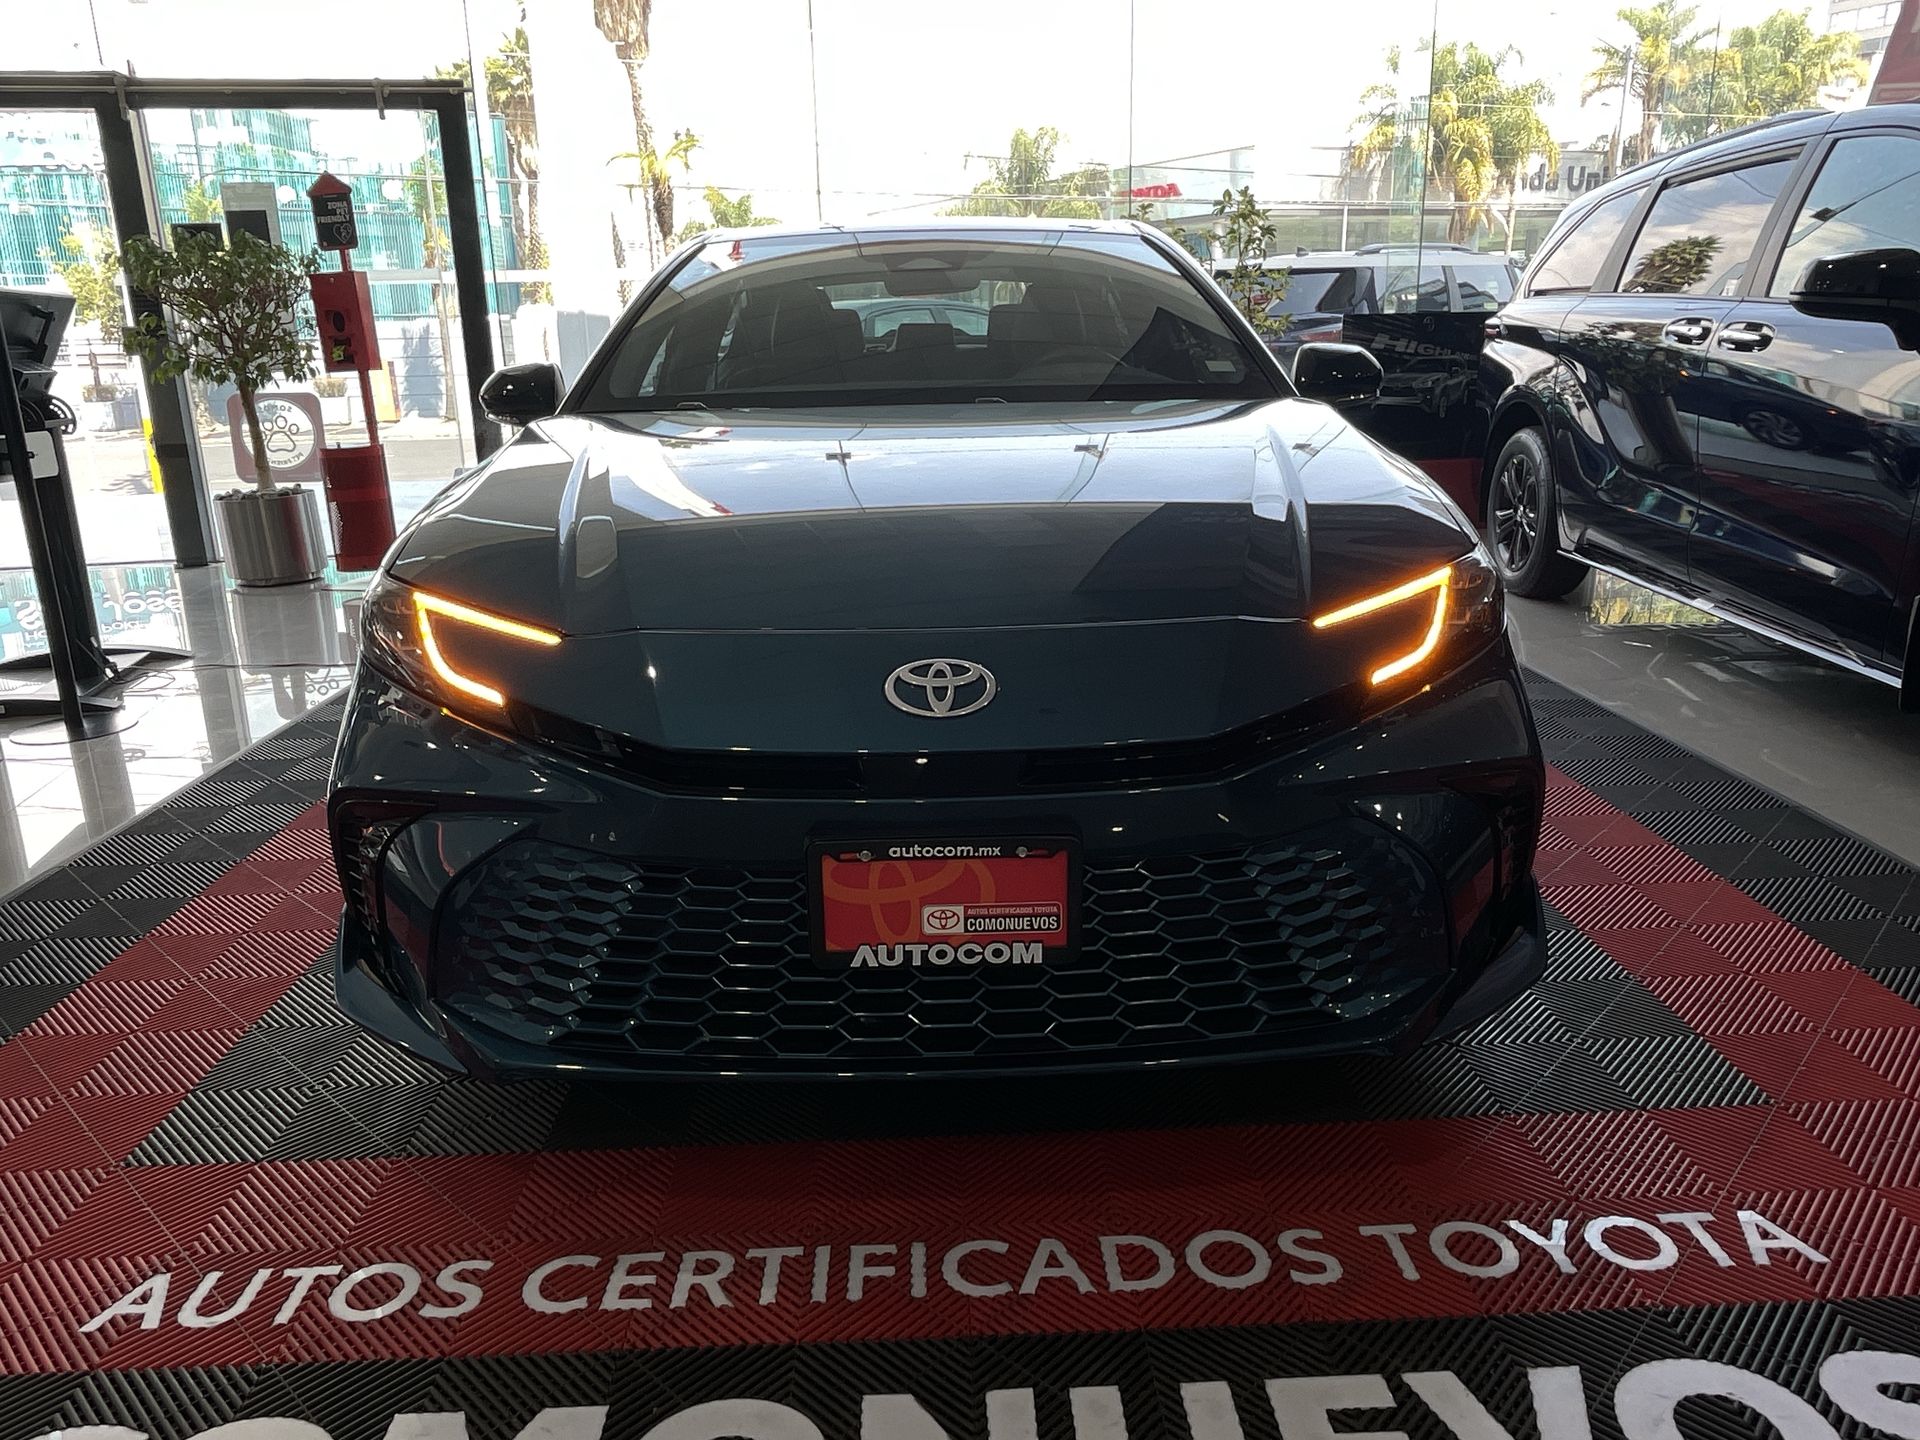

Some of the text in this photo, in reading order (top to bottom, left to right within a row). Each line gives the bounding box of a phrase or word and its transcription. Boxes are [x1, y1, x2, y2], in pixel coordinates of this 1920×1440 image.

[888, 844, 1001, 858] autocom.mx
[967, 916, 1058, 931] COMONUEVOS
[850, 942, 1043, 968] AUTOCOM
[78, 1209, 1831, 1334] AUTOS CERTIFICADOS TOYOTA
